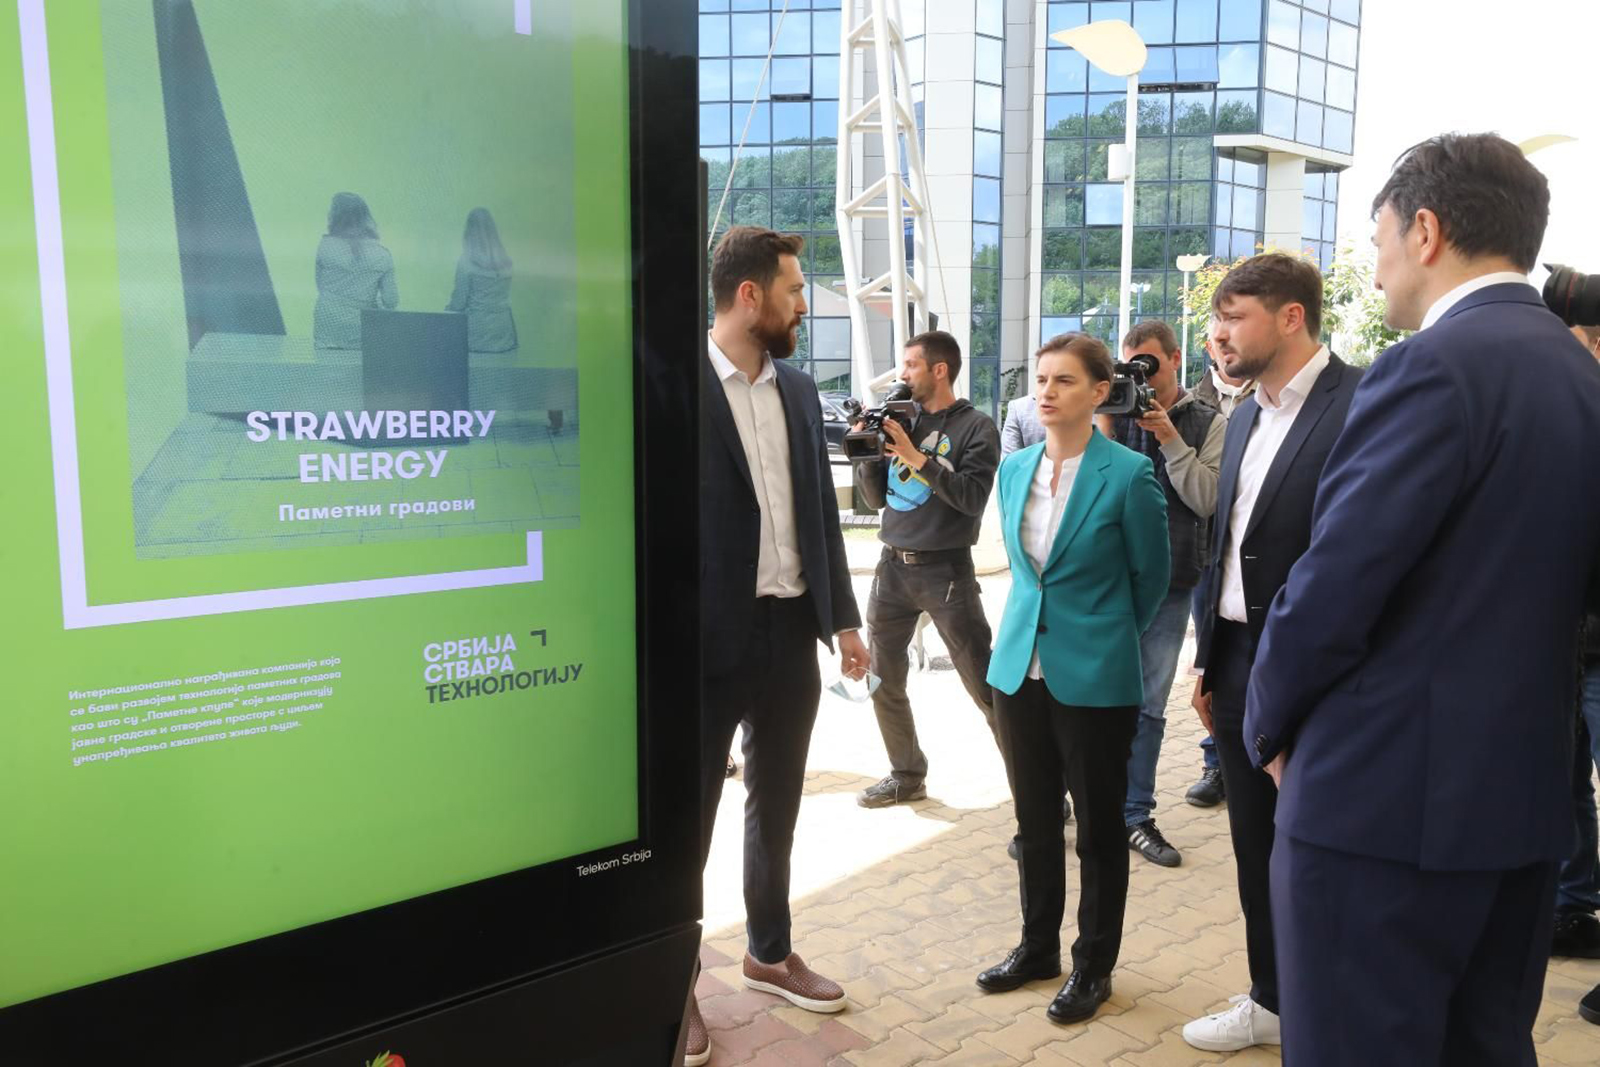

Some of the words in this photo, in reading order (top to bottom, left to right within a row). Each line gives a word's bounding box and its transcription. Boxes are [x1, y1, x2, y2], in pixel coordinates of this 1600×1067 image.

[246, 410, 496, 442] STRAWBERRY
[299, 450, 448, 483] ENERGY
[278, 502, 382, 521] Паметни
[389, 498, 476, 519] градови
[423, 633, 517, 662] СРБИЈА
[68, 678, 182, 700] Интернационално
[184, 667, 259, 684] награђивана
[262, 658, 317, 674] компанија
[320, 656, 341, 669] која
[424, 654, 515, 683] СТВАРА
[425, 663, 583, 703] ТЕХНОЛОГИЈУ
[70, 708, 85, 716] се
[88, 703, 119, 713] бави
[122, 694, 176, 711] развојем
[179, 684, 244, 700] технологија
[247, 678, 298, 690] паметних
[300, 671, 342, 684] градова
[71, 722, 94, 732] као
[97, 719, 120, 728] што
[123, 716, 138, 726] су
[242, 696, 263, 707] које
[266, 685, 333, 702] модернизују
[72, 737, 105, 751] јавне
[109, 729, 157, 744] градске
[160, 726, 167, 734] и
[170, 717, 222, 732] отворене
[225, 709, 275, 724] просторе
[278, 707, 284, 715] с
[287, 702, 324, 714] циљем
[73, 742, 167, 766] унапређивања
[170, 731, 227, 747] квалитета
[229, 725, 267, 738] живота
[576, 859, 620, 877] Telekom
[622, 849, 651, 865] Srbija
